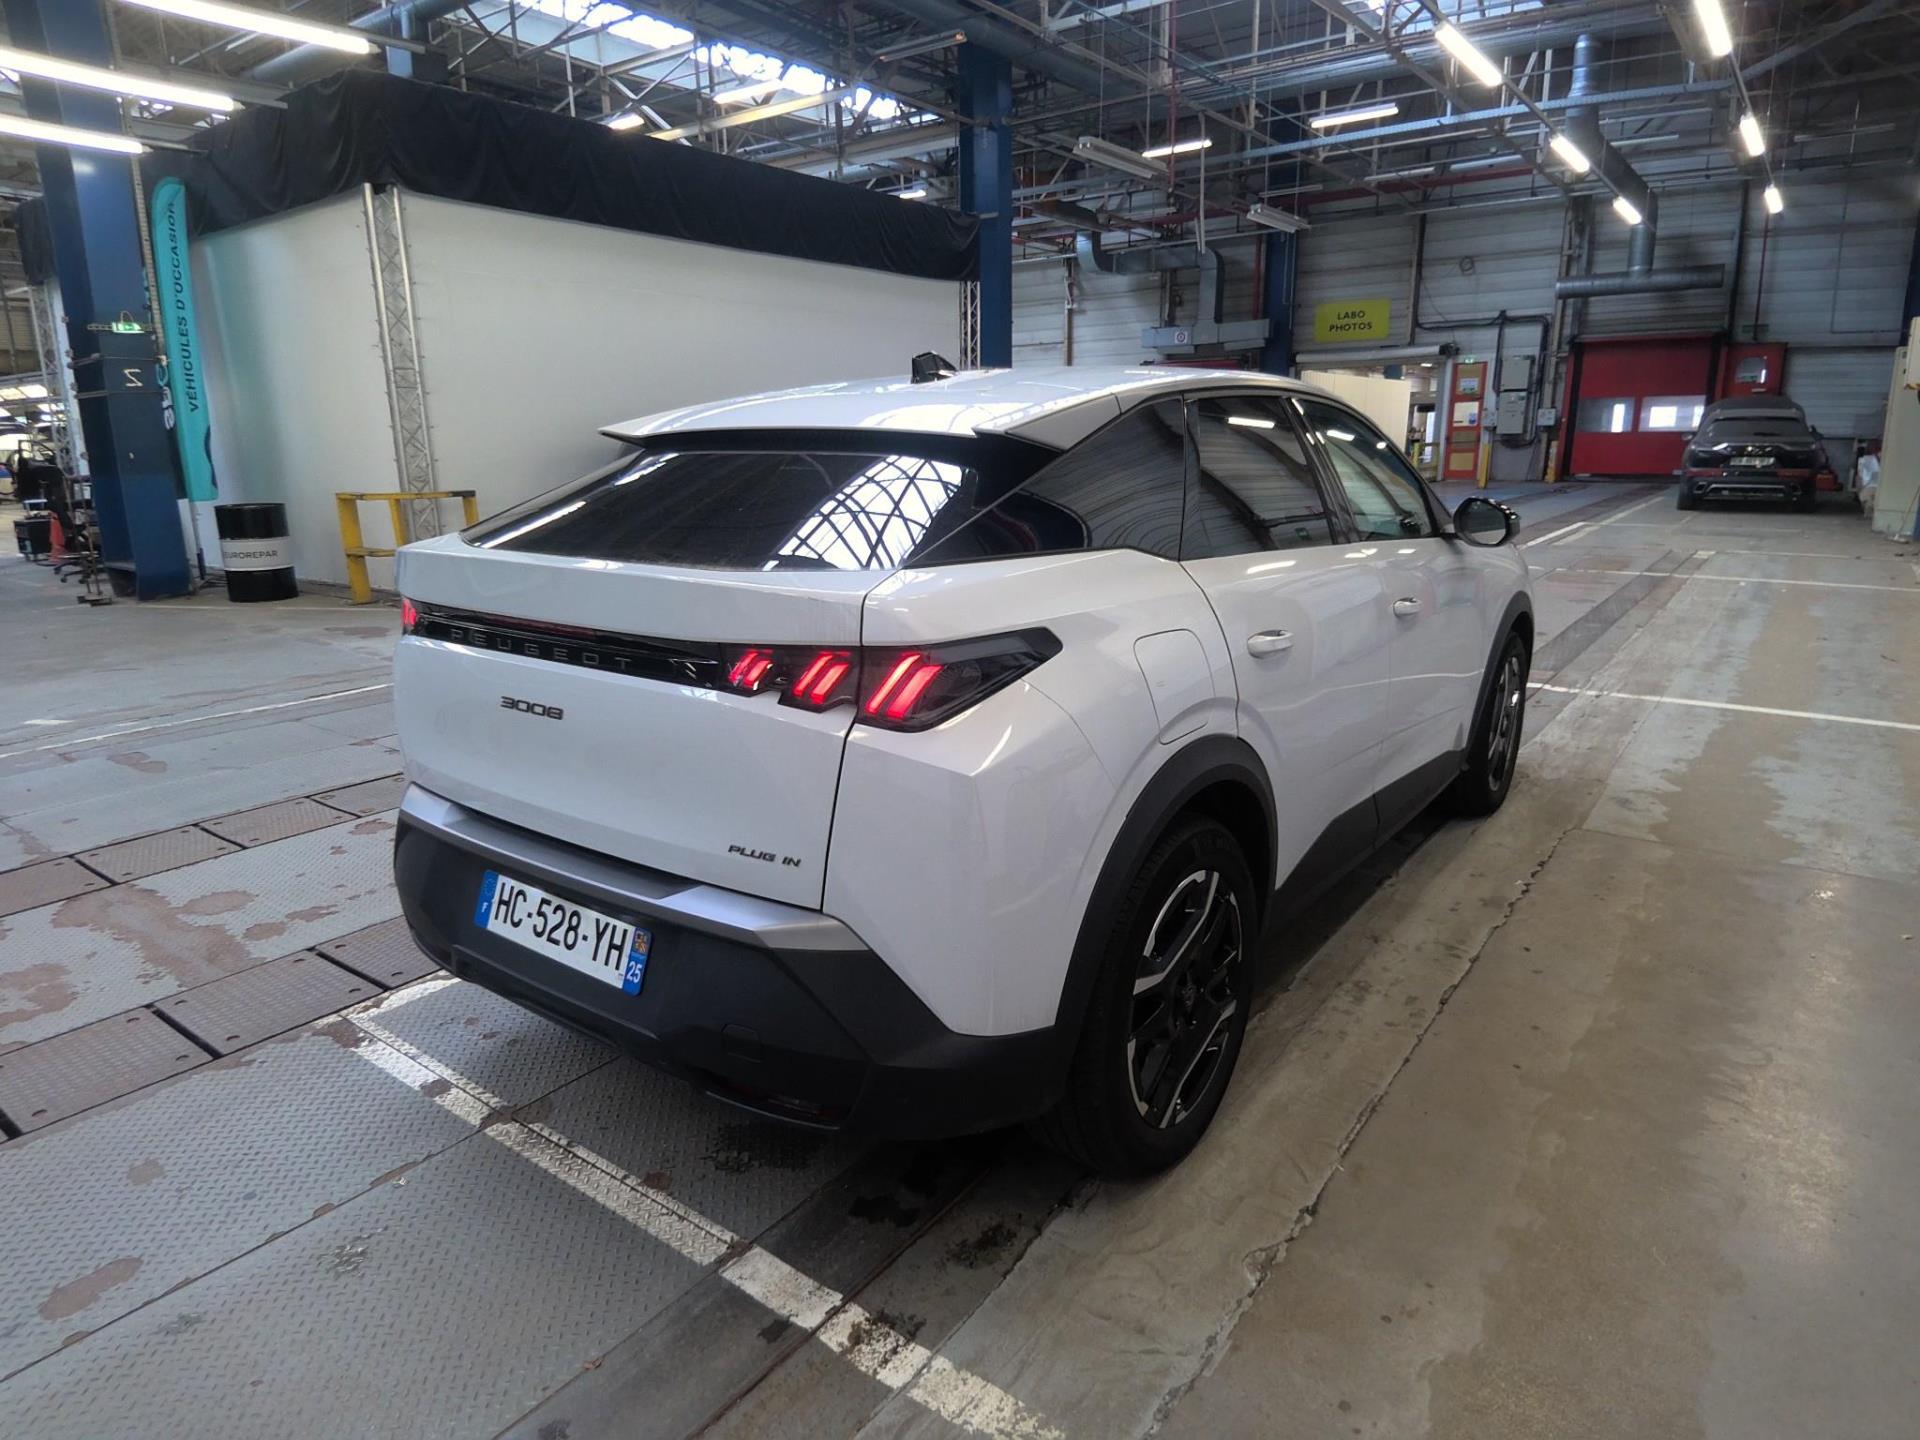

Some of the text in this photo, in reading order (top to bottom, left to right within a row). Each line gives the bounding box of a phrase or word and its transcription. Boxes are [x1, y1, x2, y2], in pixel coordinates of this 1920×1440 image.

[1329, 321, 1372, 332] PHOTOS
[1337, 310, 1365, 320] LABO
[178, 316, 199, 412] VÉHICULES
[451, 628, 632, 670] PEUGEOT
[501, 695, 563, 720] 3008
[728, 845, 801, 867] PLUG IN
[494, 882, 628, 971] HC-528-YH
[626, 961, 643, 983] 25
